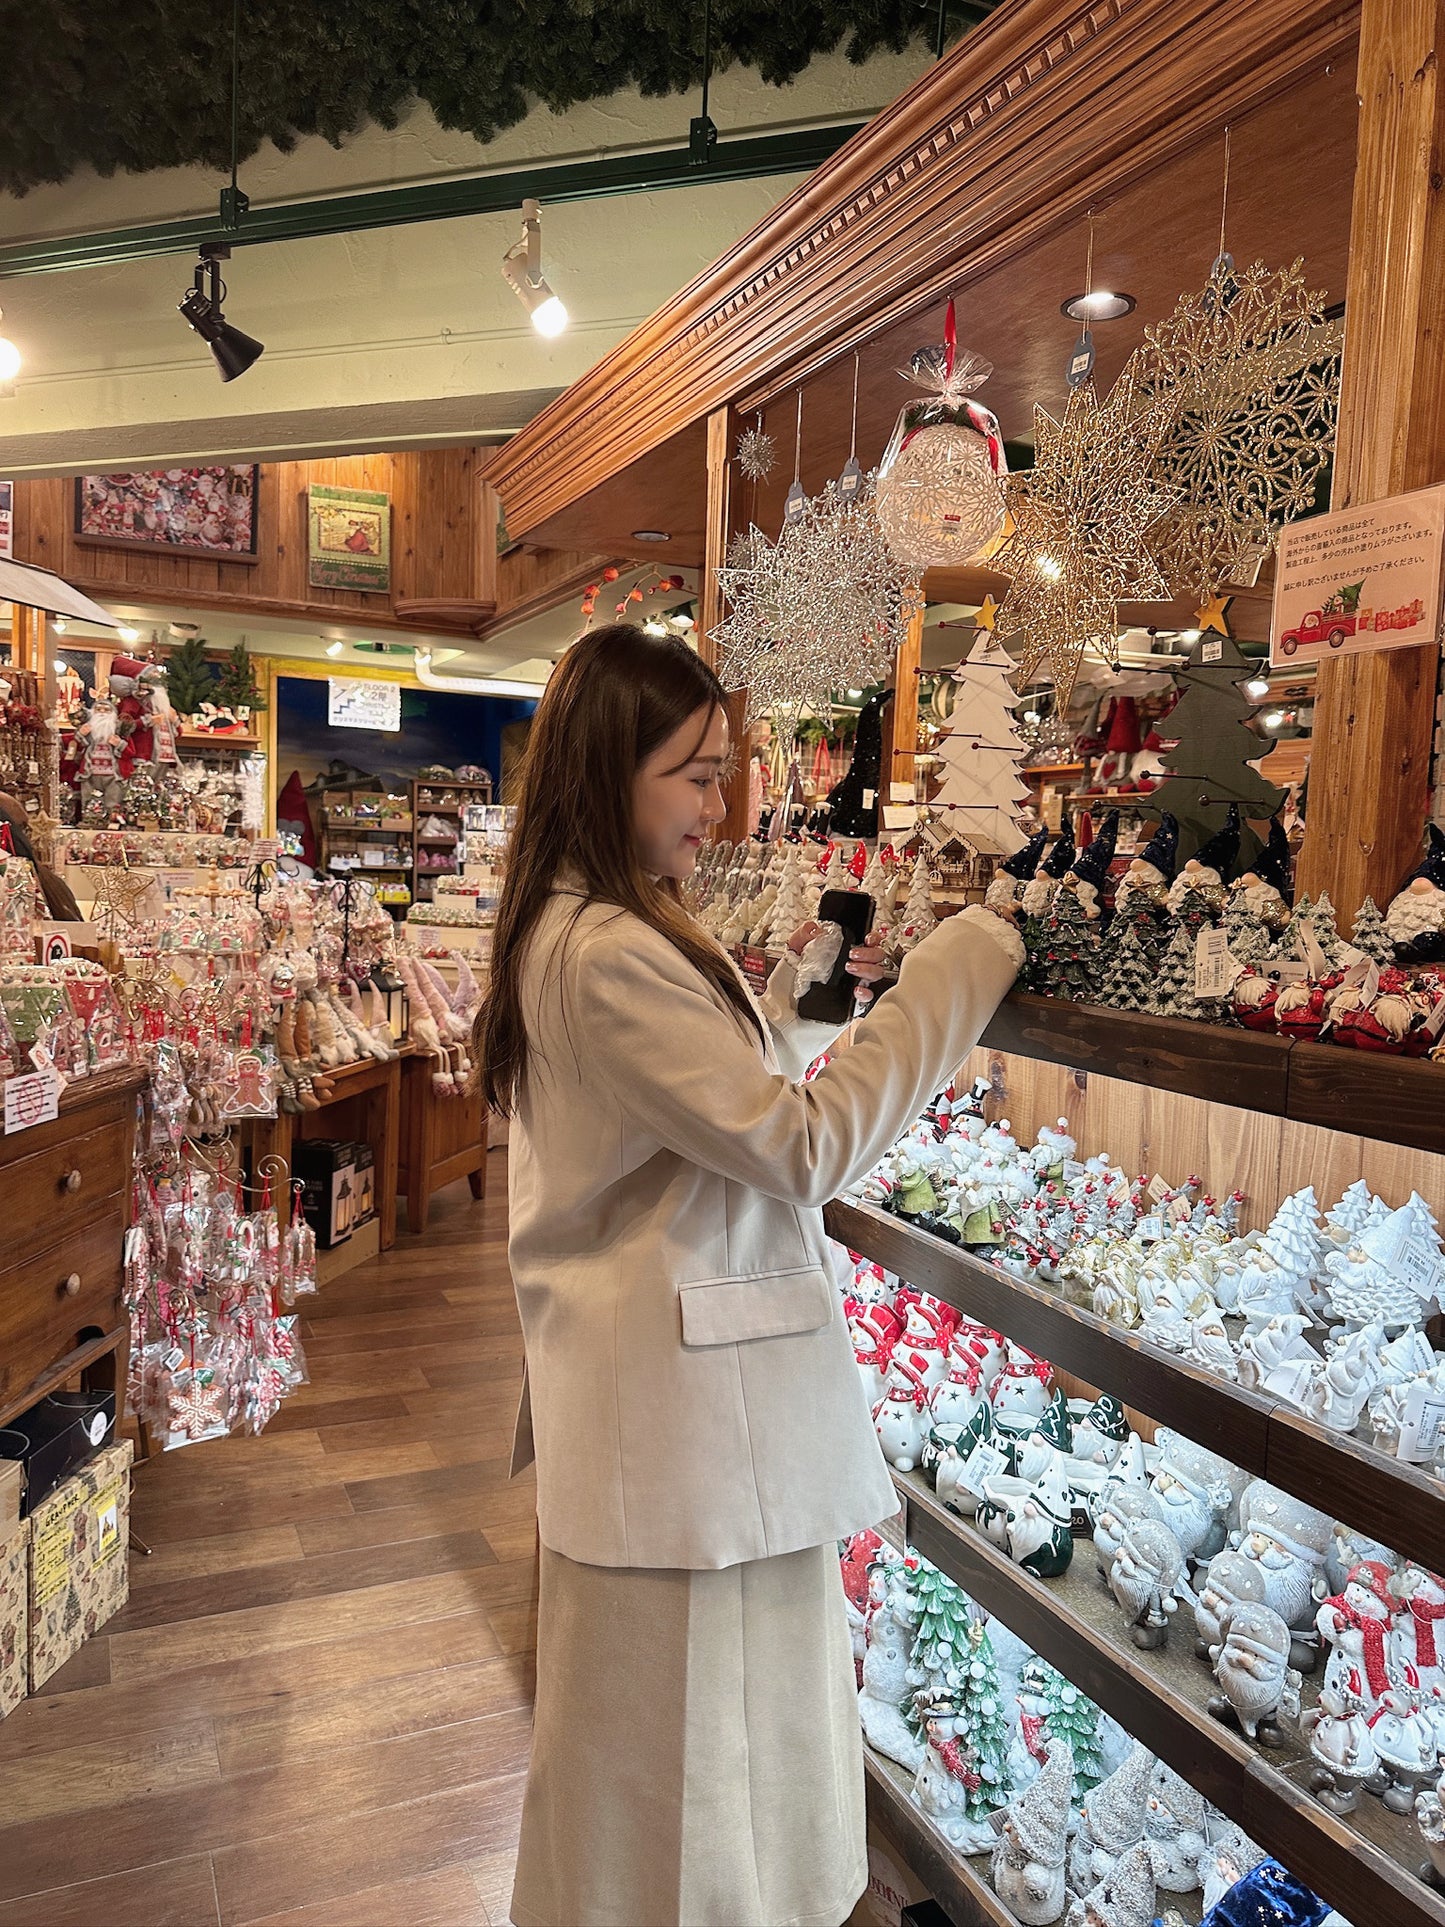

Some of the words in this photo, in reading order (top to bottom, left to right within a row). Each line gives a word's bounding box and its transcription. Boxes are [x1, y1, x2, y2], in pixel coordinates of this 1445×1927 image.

[1286, 522, 1412, 558] 海外からの直輸入の商品となっております。
[1287, 518, 1376, 546] 当店で販売している商品は全て
[1284, 557, 1425, 591] 誠に申し訳ございませんが予めご了承ください。
